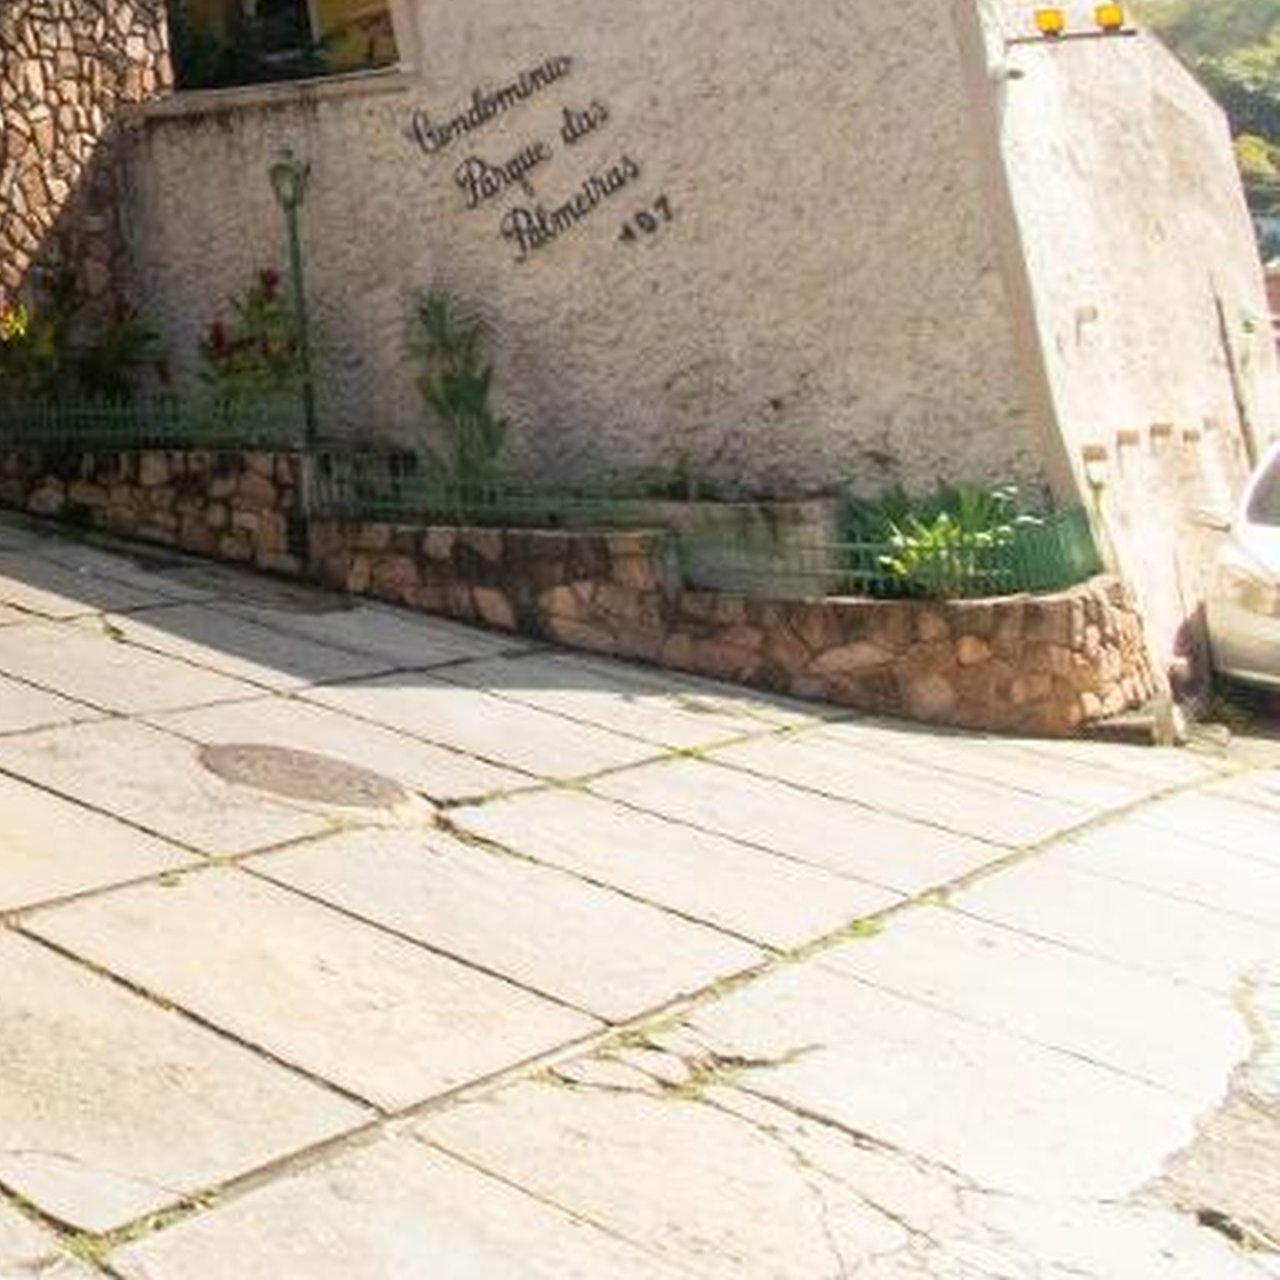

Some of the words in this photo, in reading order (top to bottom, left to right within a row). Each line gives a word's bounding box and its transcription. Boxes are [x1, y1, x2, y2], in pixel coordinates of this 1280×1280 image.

[454, 142, 552, 210] Parque
[560, 100, 608, 144] das
[500, 154, 639, 264] Palmeiras
